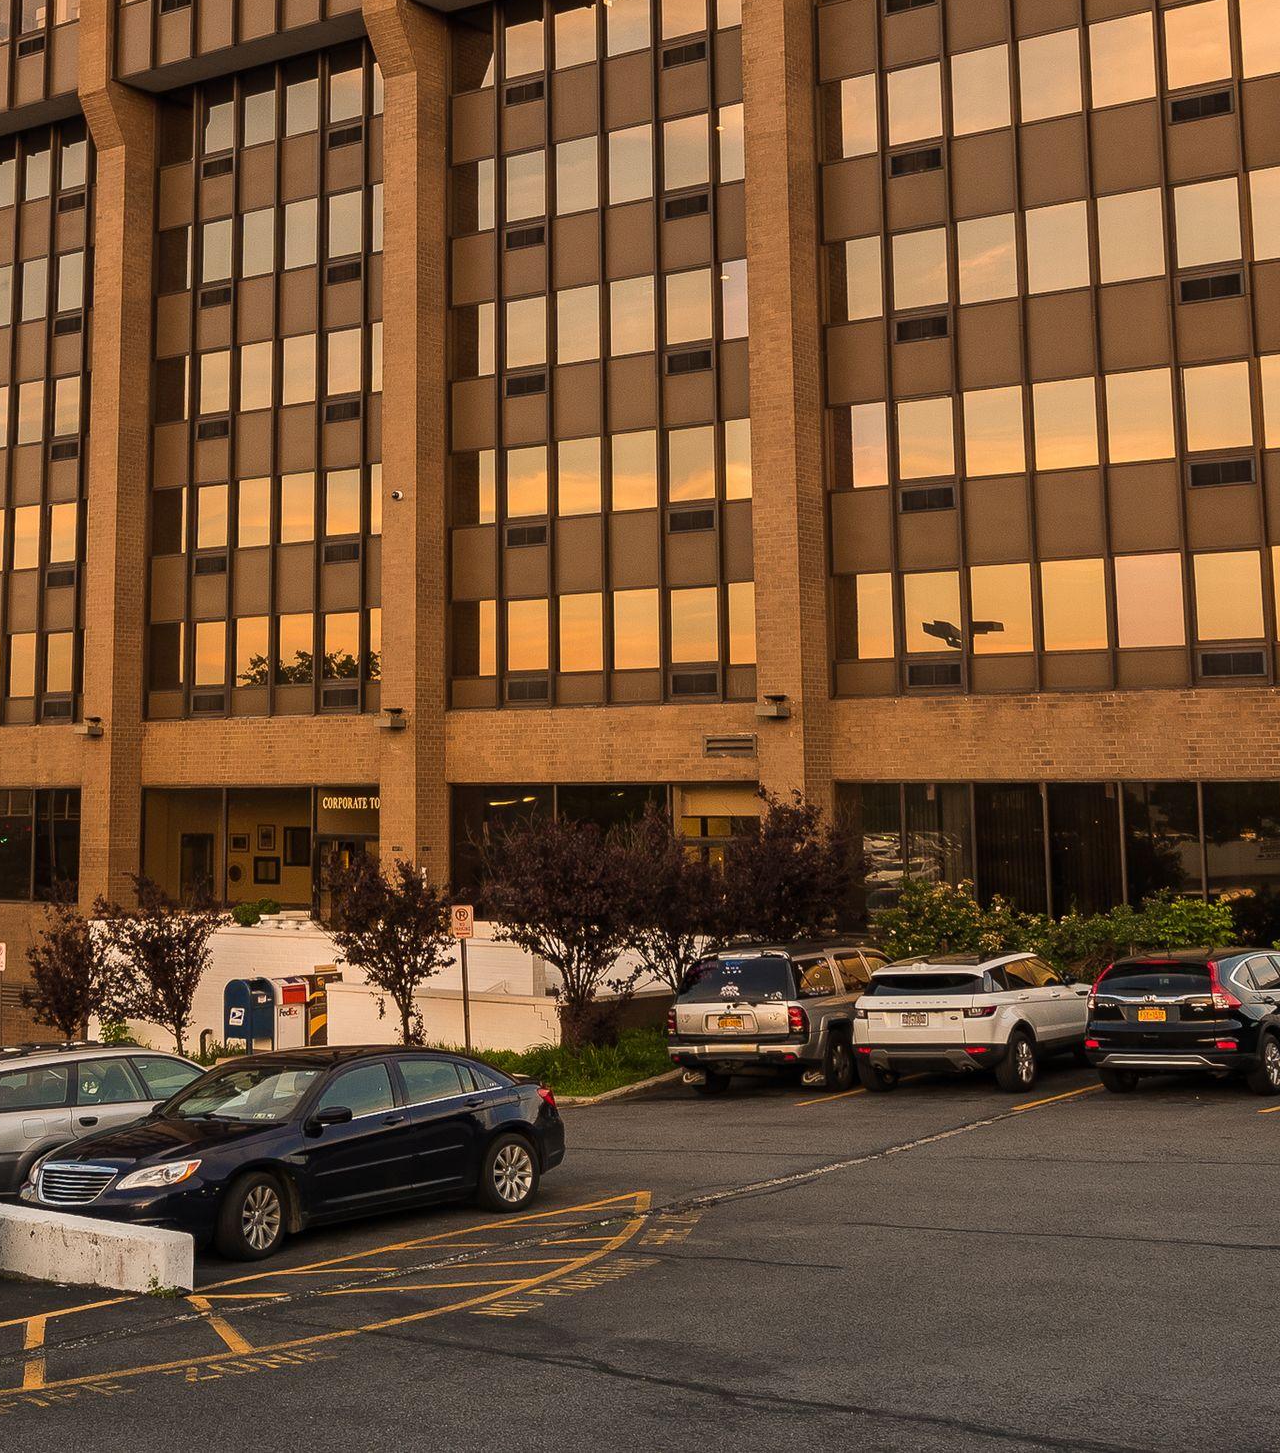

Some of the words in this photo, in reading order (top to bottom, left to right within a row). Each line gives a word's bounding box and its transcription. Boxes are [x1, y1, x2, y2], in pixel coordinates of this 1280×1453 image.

[322, 796, 368, 809] CORPORATE
[279, 1007, 298, 1017] FedEx
[163, 1348, 337, 1384] ZONE
